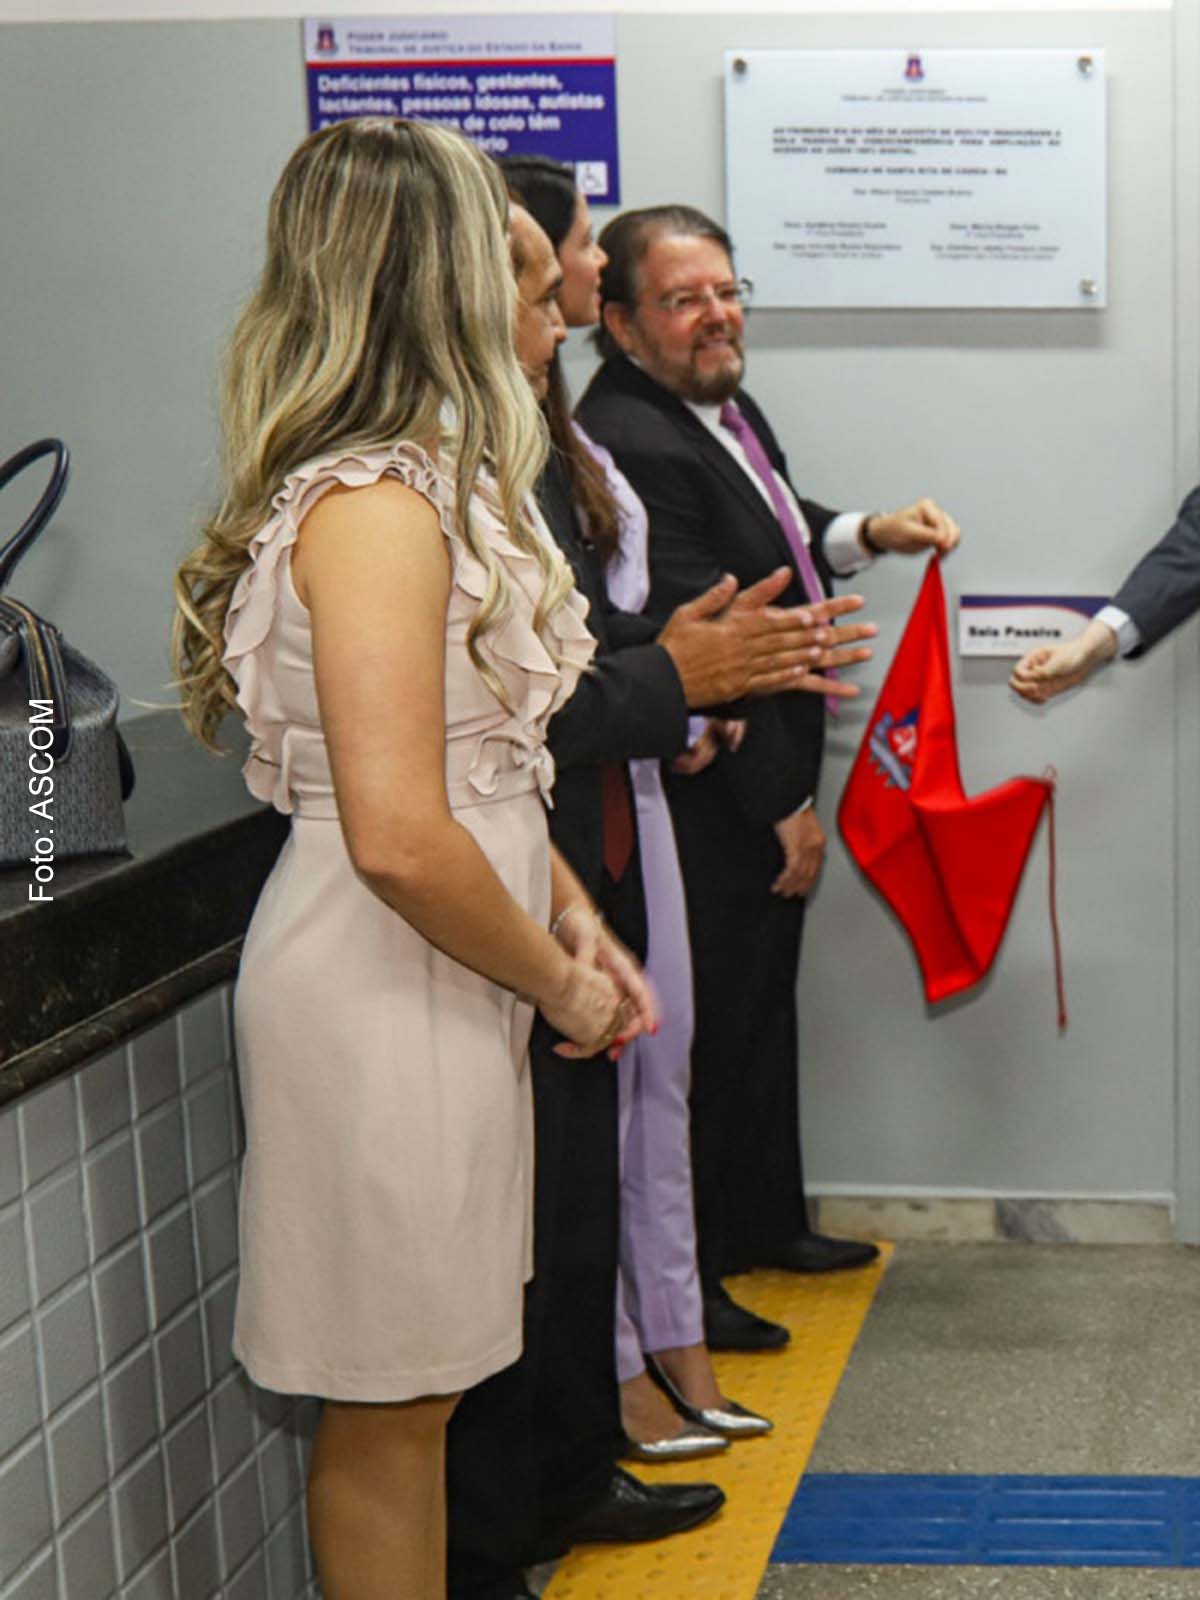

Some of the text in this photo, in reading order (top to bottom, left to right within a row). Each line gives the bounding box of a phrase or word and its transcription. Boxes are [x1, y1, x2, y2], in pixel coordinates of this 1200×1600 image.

[317, 74, 411, 92] Deficientes
[476, 72, 564, 93] gestantes,
[317, 92, 605, 115] lactantes, pessoas idosas, autistas
[462, 114, 486, 132] de
[488, 114, 526, 132] colo
[1004, 625, 1063, 638] Passiva
